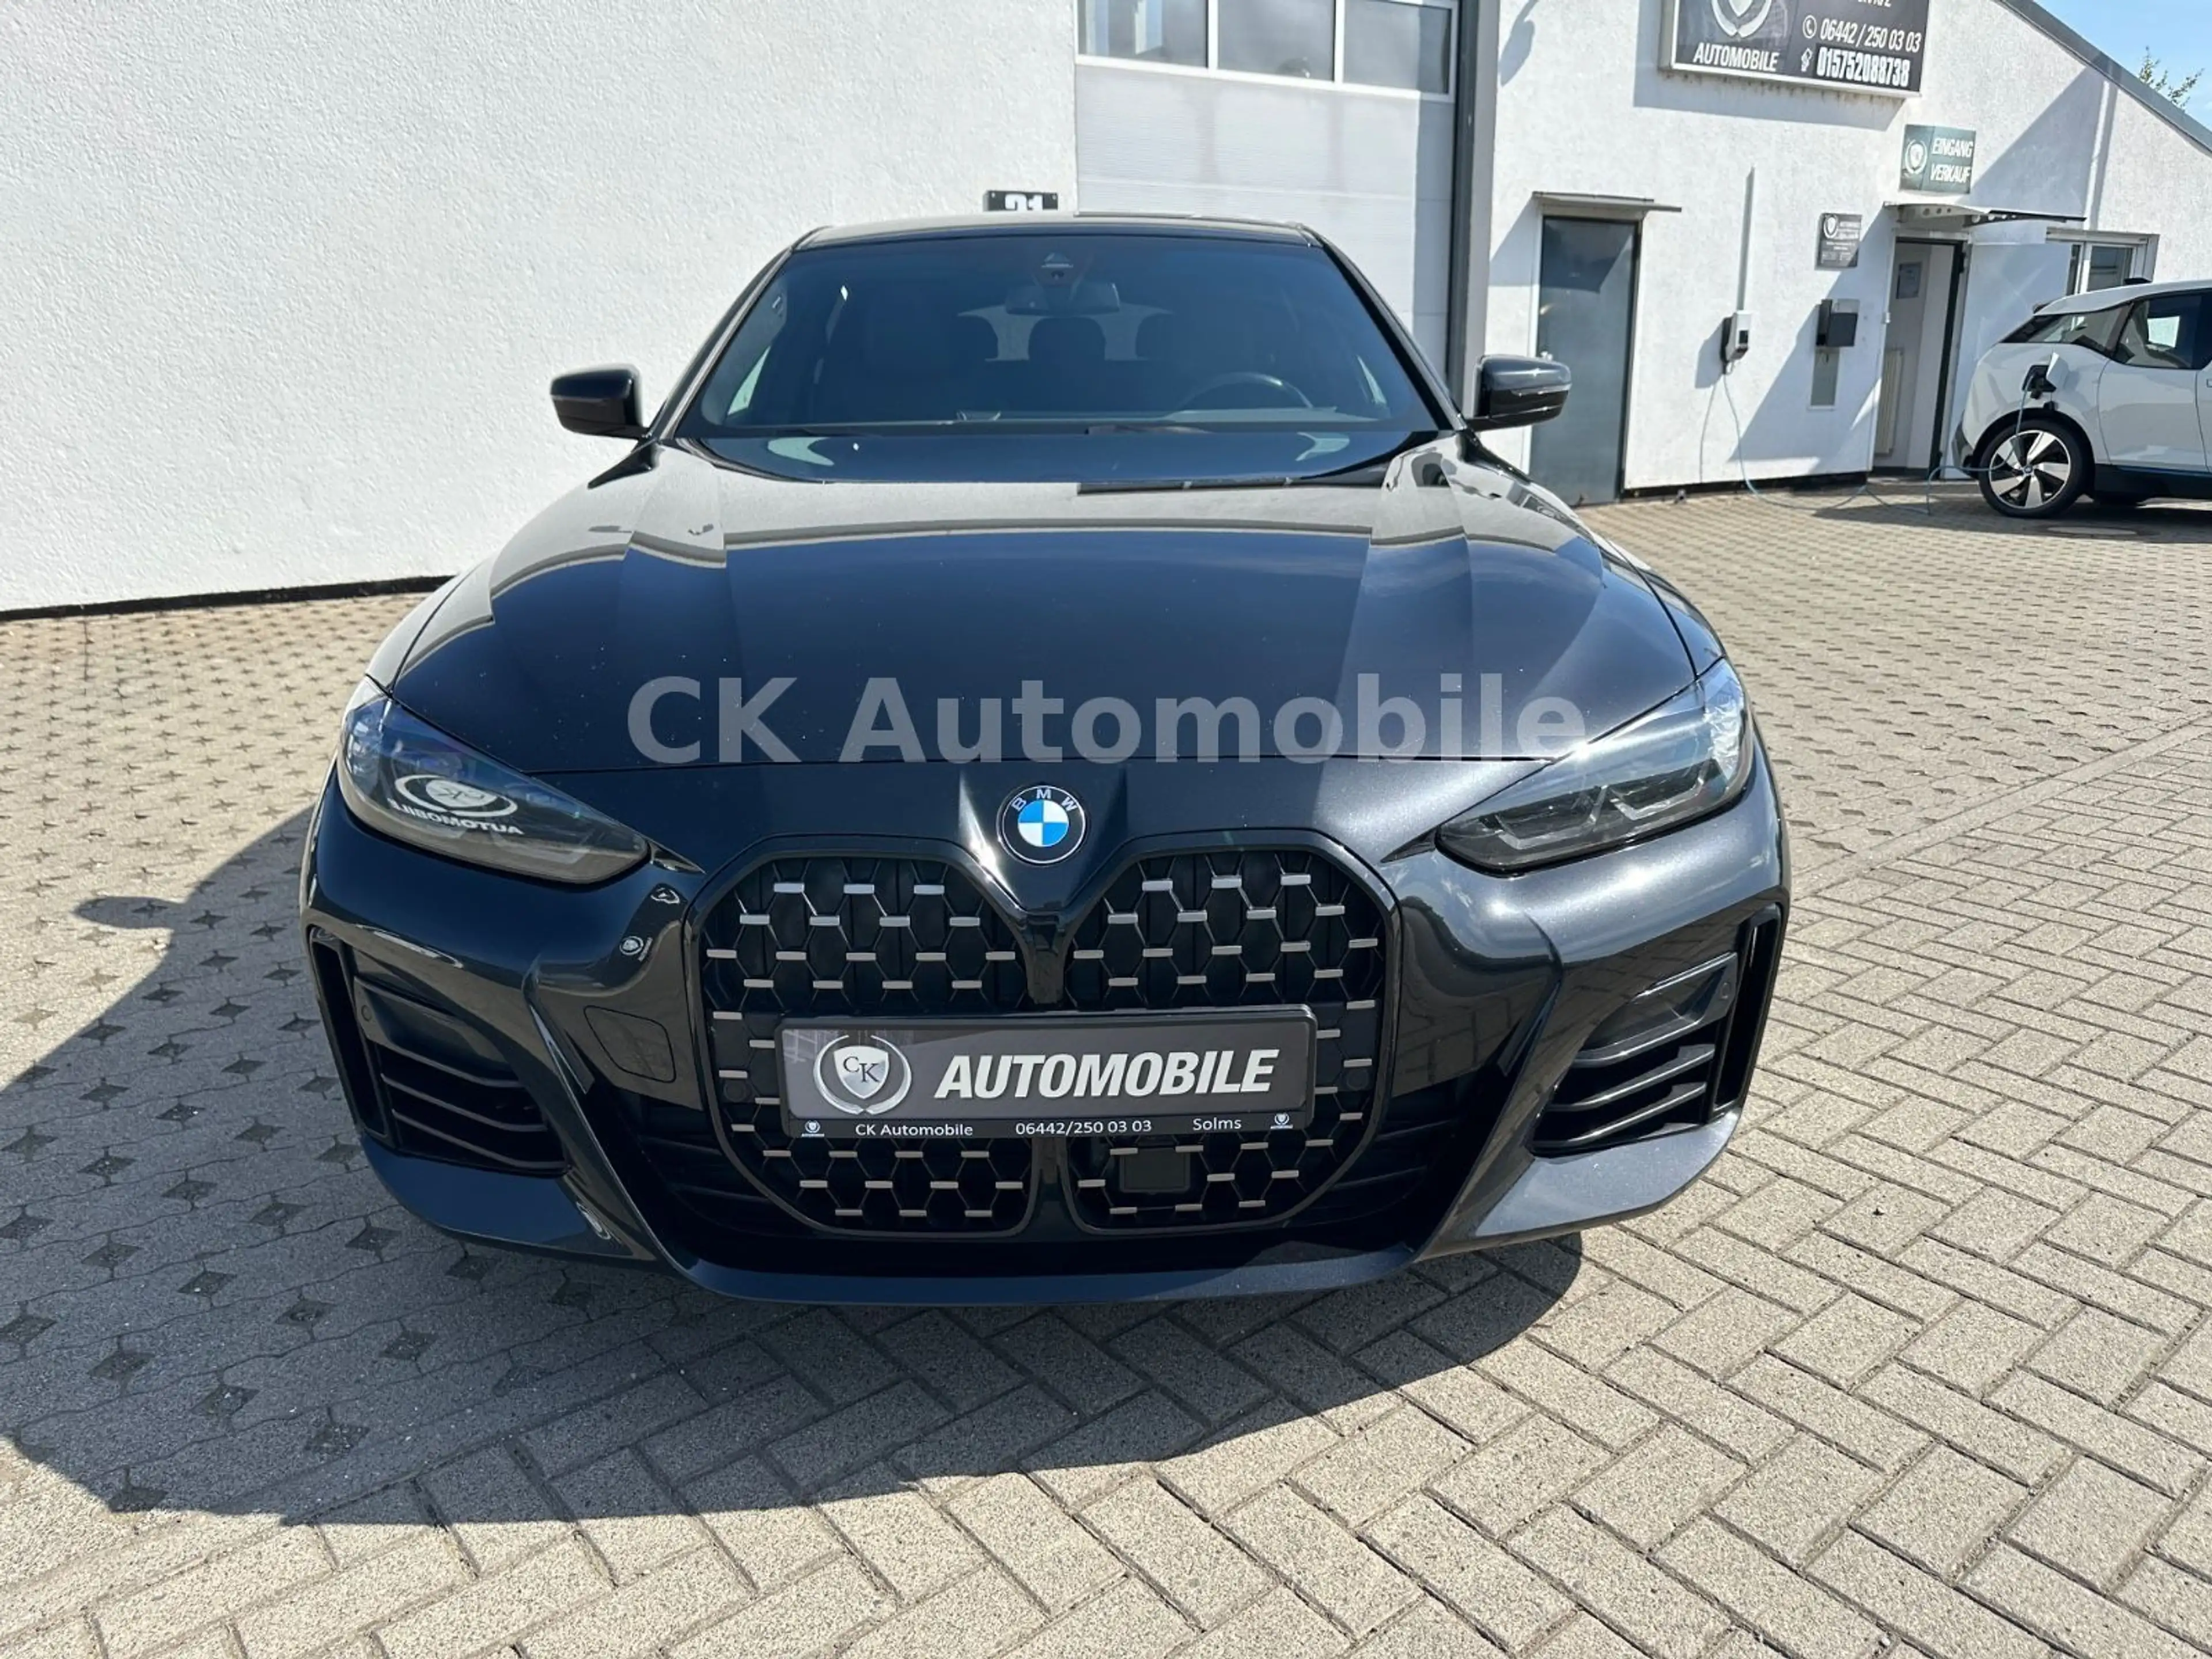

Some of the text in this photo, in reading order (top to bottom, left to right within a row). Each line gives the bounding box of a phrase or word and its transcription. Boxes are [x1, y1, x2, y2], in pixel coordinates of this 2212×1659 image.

[1820, 18, 1858, 44] 06442
[1864, 26, 1888, 48] 250
[1888, 29, 1905, 51] 03
[1905, 32, 1922, 53] 03
[1692, 42, 1780, 71] AUTOMOBILE
[1816, 47, 1911, 87] 015752088738
[1931, 138, 1974, 158] EINGANG
[1930, 164, 1971, 183] VERKAUF
[1011, 788, 1078, 812] BMW
[843, 1056, 880, 1083] CK
[934, 1048, 1280, 1099] AUTOMOBILE
[855, 1123, 974, 1137] CK Automobile
[1015, 1120, 1152, 1135] 06442/250 03 03
[1192, 1116, 1242, 1131] Solms
